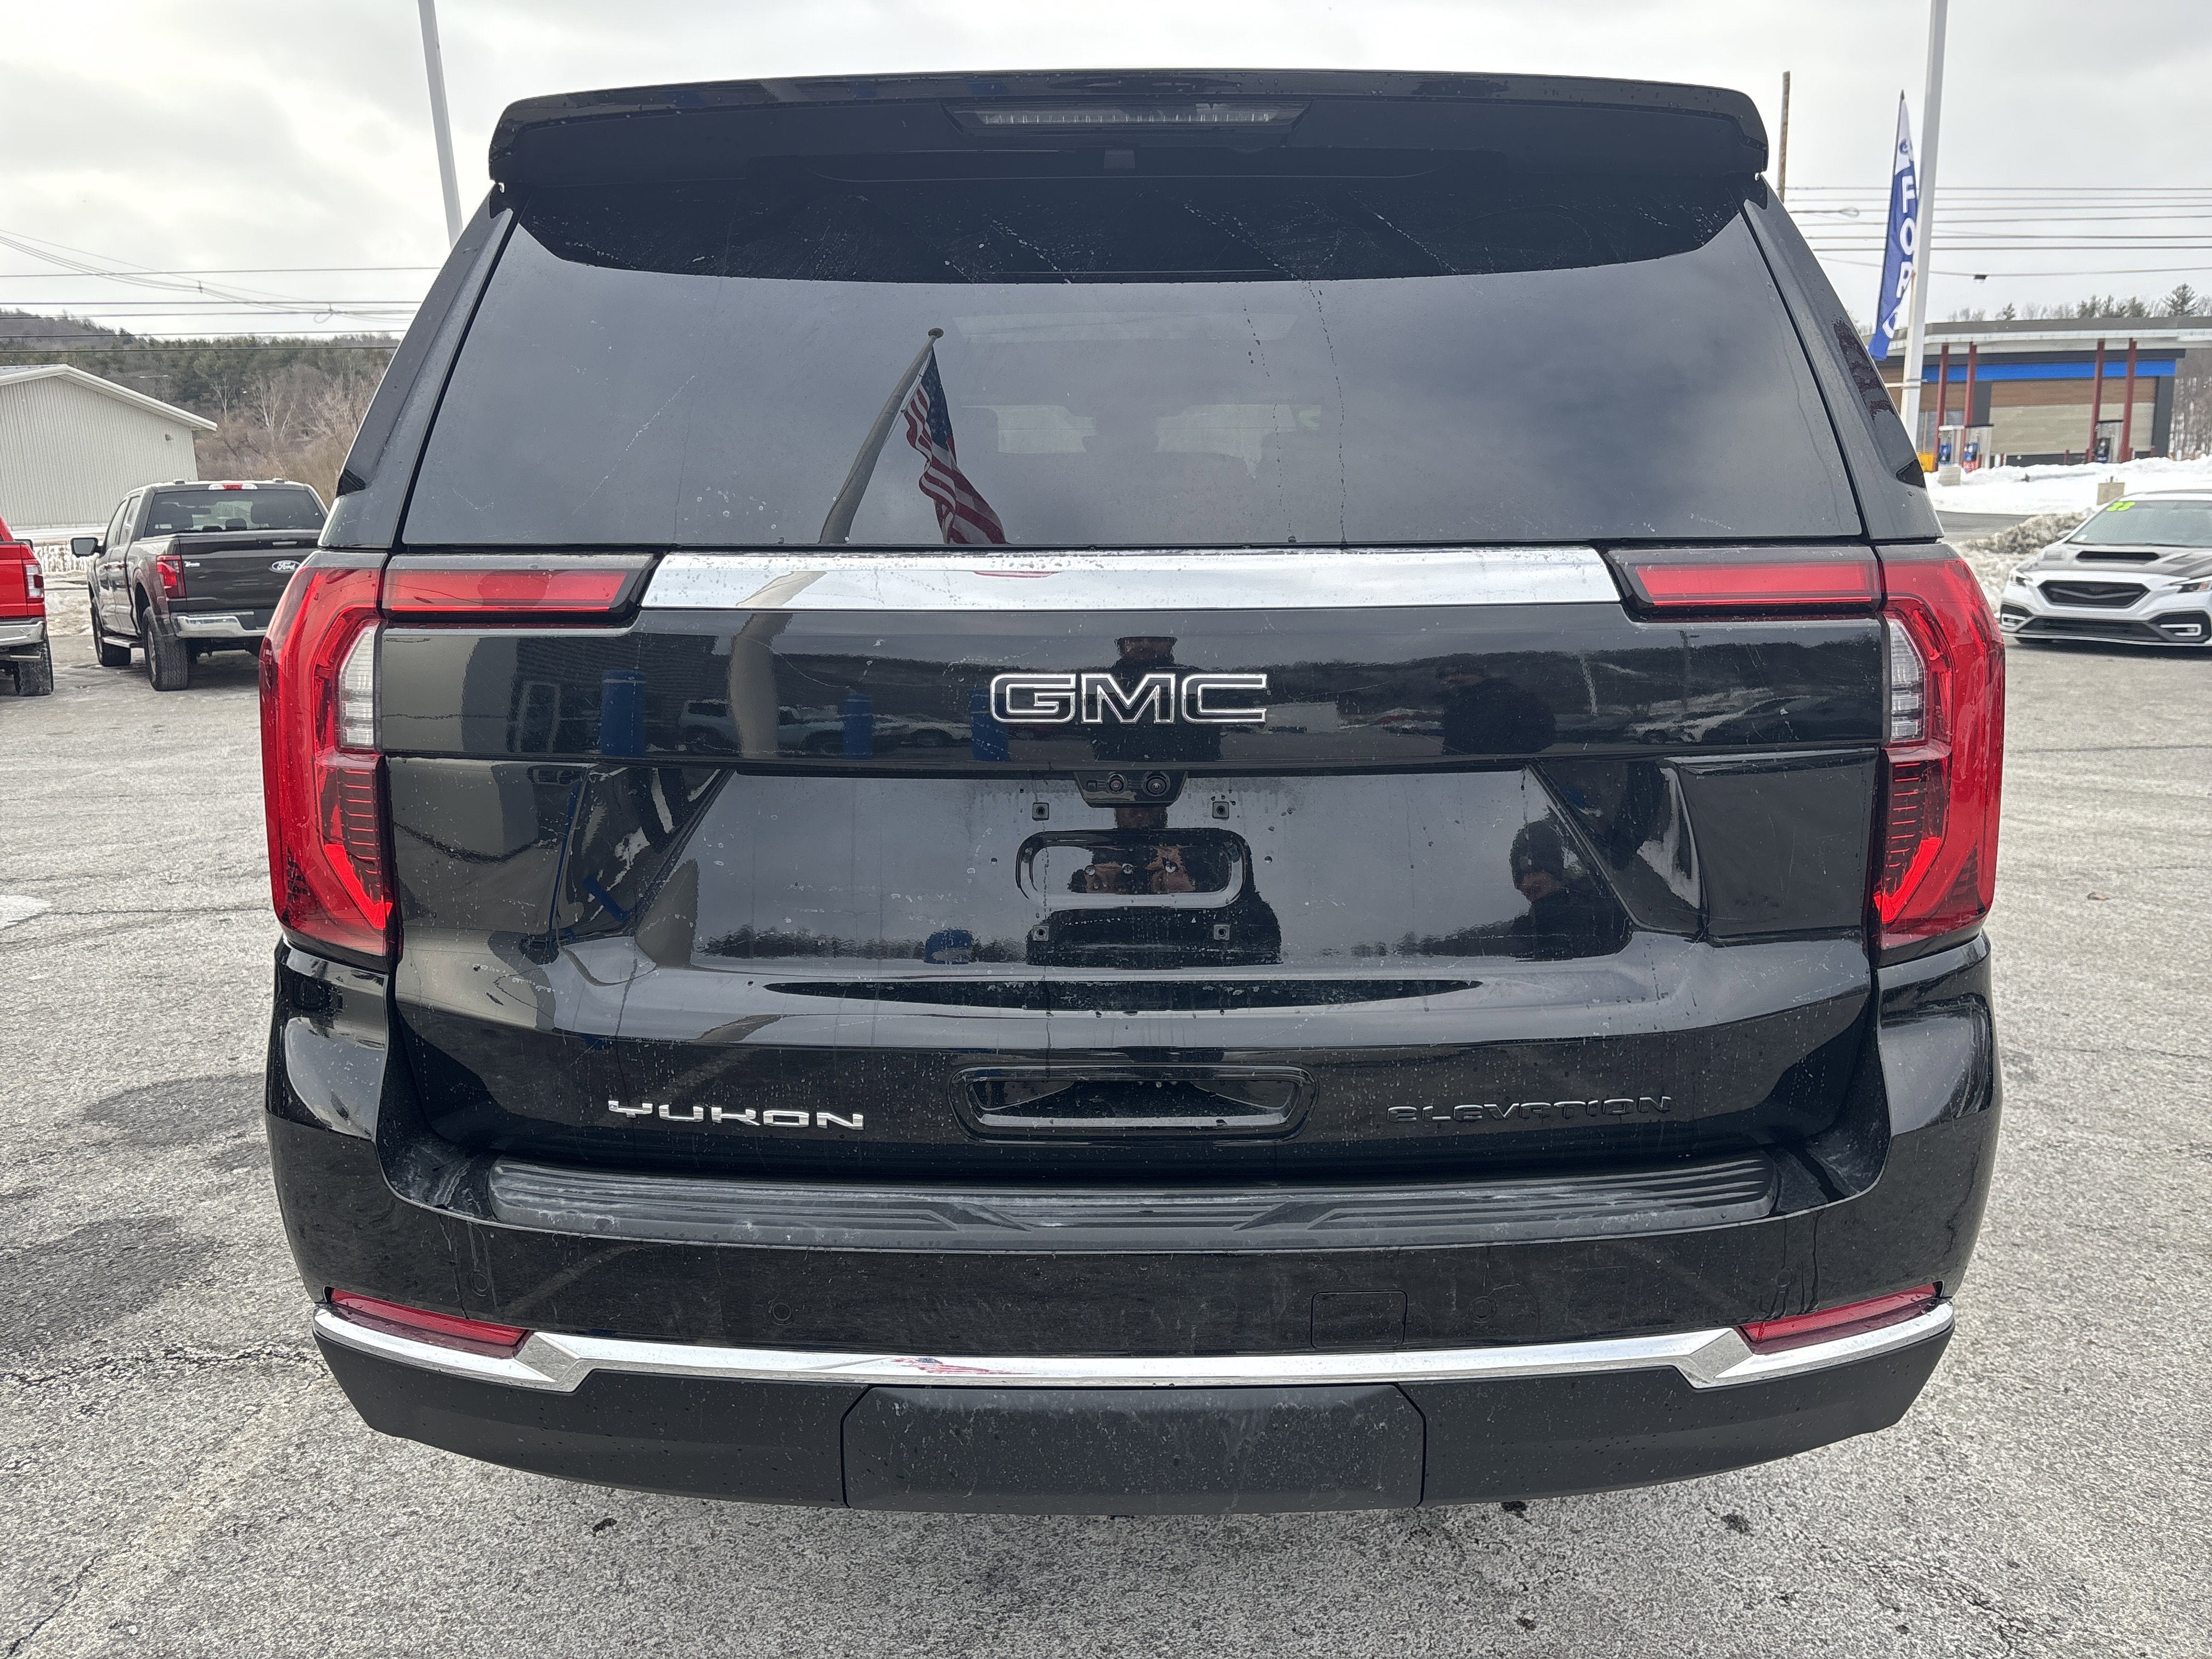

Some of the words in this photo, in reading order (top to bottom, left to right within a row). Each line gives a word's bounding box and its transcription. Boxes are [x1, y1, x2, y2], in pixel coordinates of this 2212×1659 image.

[276, 561, 296, 571] Ford
[990, 673, 1267, 724] GMC
[608, 1101, 864, 1130] YUKON
[1387, 1096, 1672, 1124] ELEVATION
